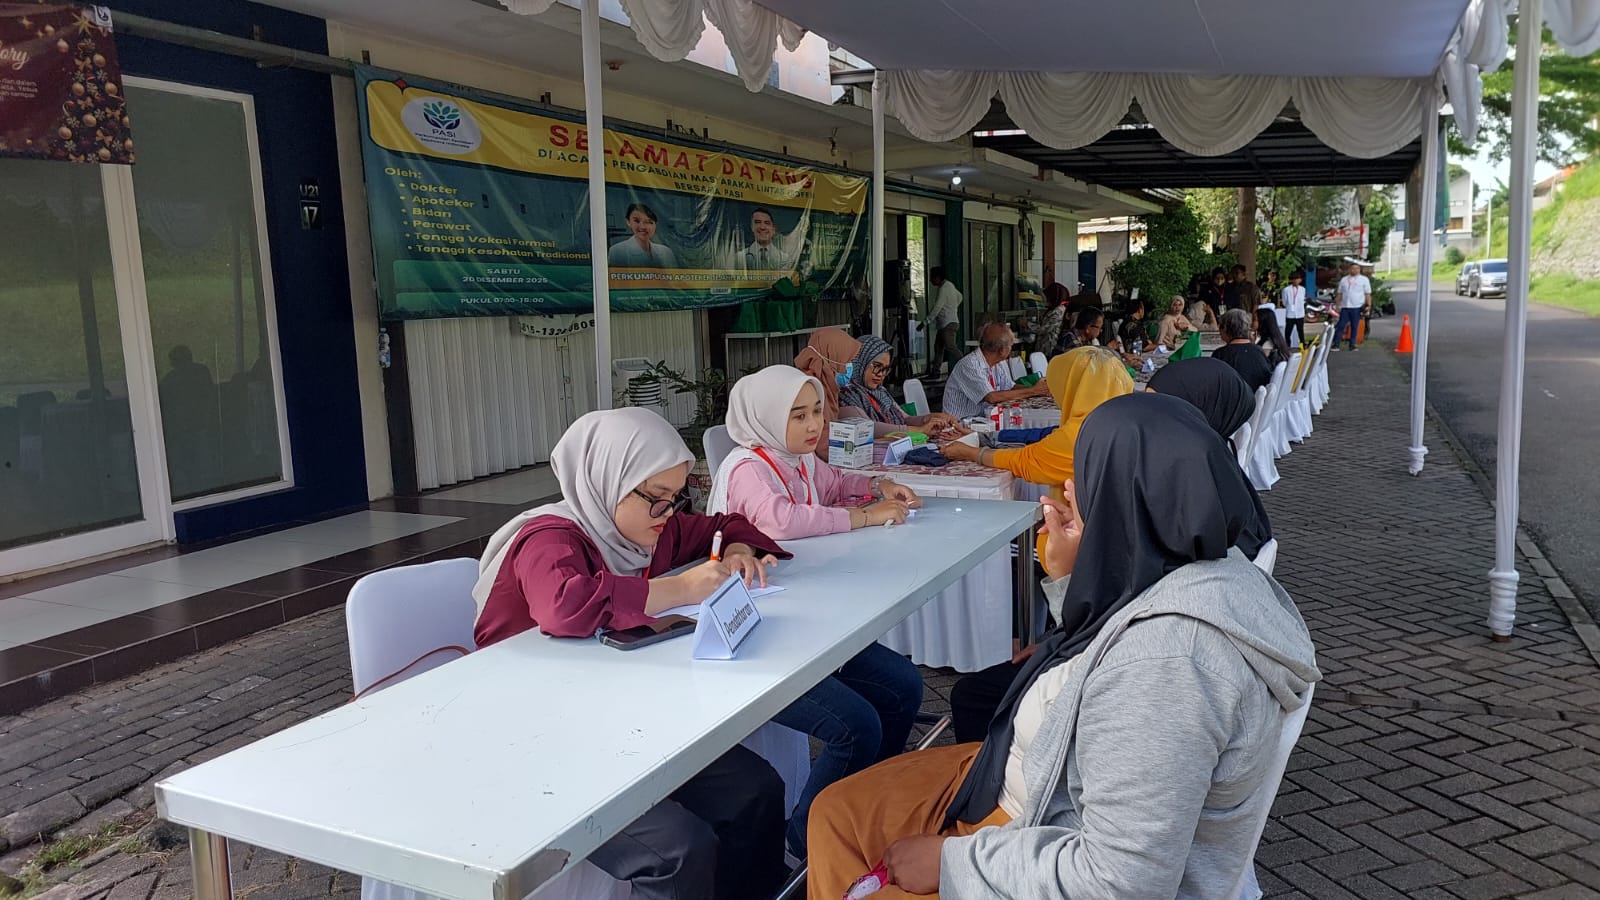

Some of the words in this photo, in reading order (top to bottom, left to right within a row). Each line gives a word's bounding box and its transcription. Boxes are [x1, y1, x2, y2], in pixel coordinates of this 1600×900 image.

[432, 129, 456, 138] PASI
[549, 125, 708, 172] SEAMAT
[721, 158, 814, 190] DATANG
[538, 149, 552, 159] DI
[613, 159, 688, 180] PENGABDIAN
[384, 167, 422, 180] Oleh:
[410, 183, 459, 195] Dokter
[724, 188, 743, 198] PASI
[411, 196, 474, 209] Apoteker
[303, 206, 319, 225] 17
[412, 207, 452, 218] Bidan
[412, 220, 472, 231] Perawat
[414, 232, 464, 244] Tenaga
[468, 235, 511, 245] Vokasi
[512, 238, 555, 248] Farmasi
[416, 244, 464, 255] Tenaga
[467, 246, 533, 257] Kesehatan
[535, 249, 590, 259] Tradisional
[723, 603, 755, 638] Pendaftaran
